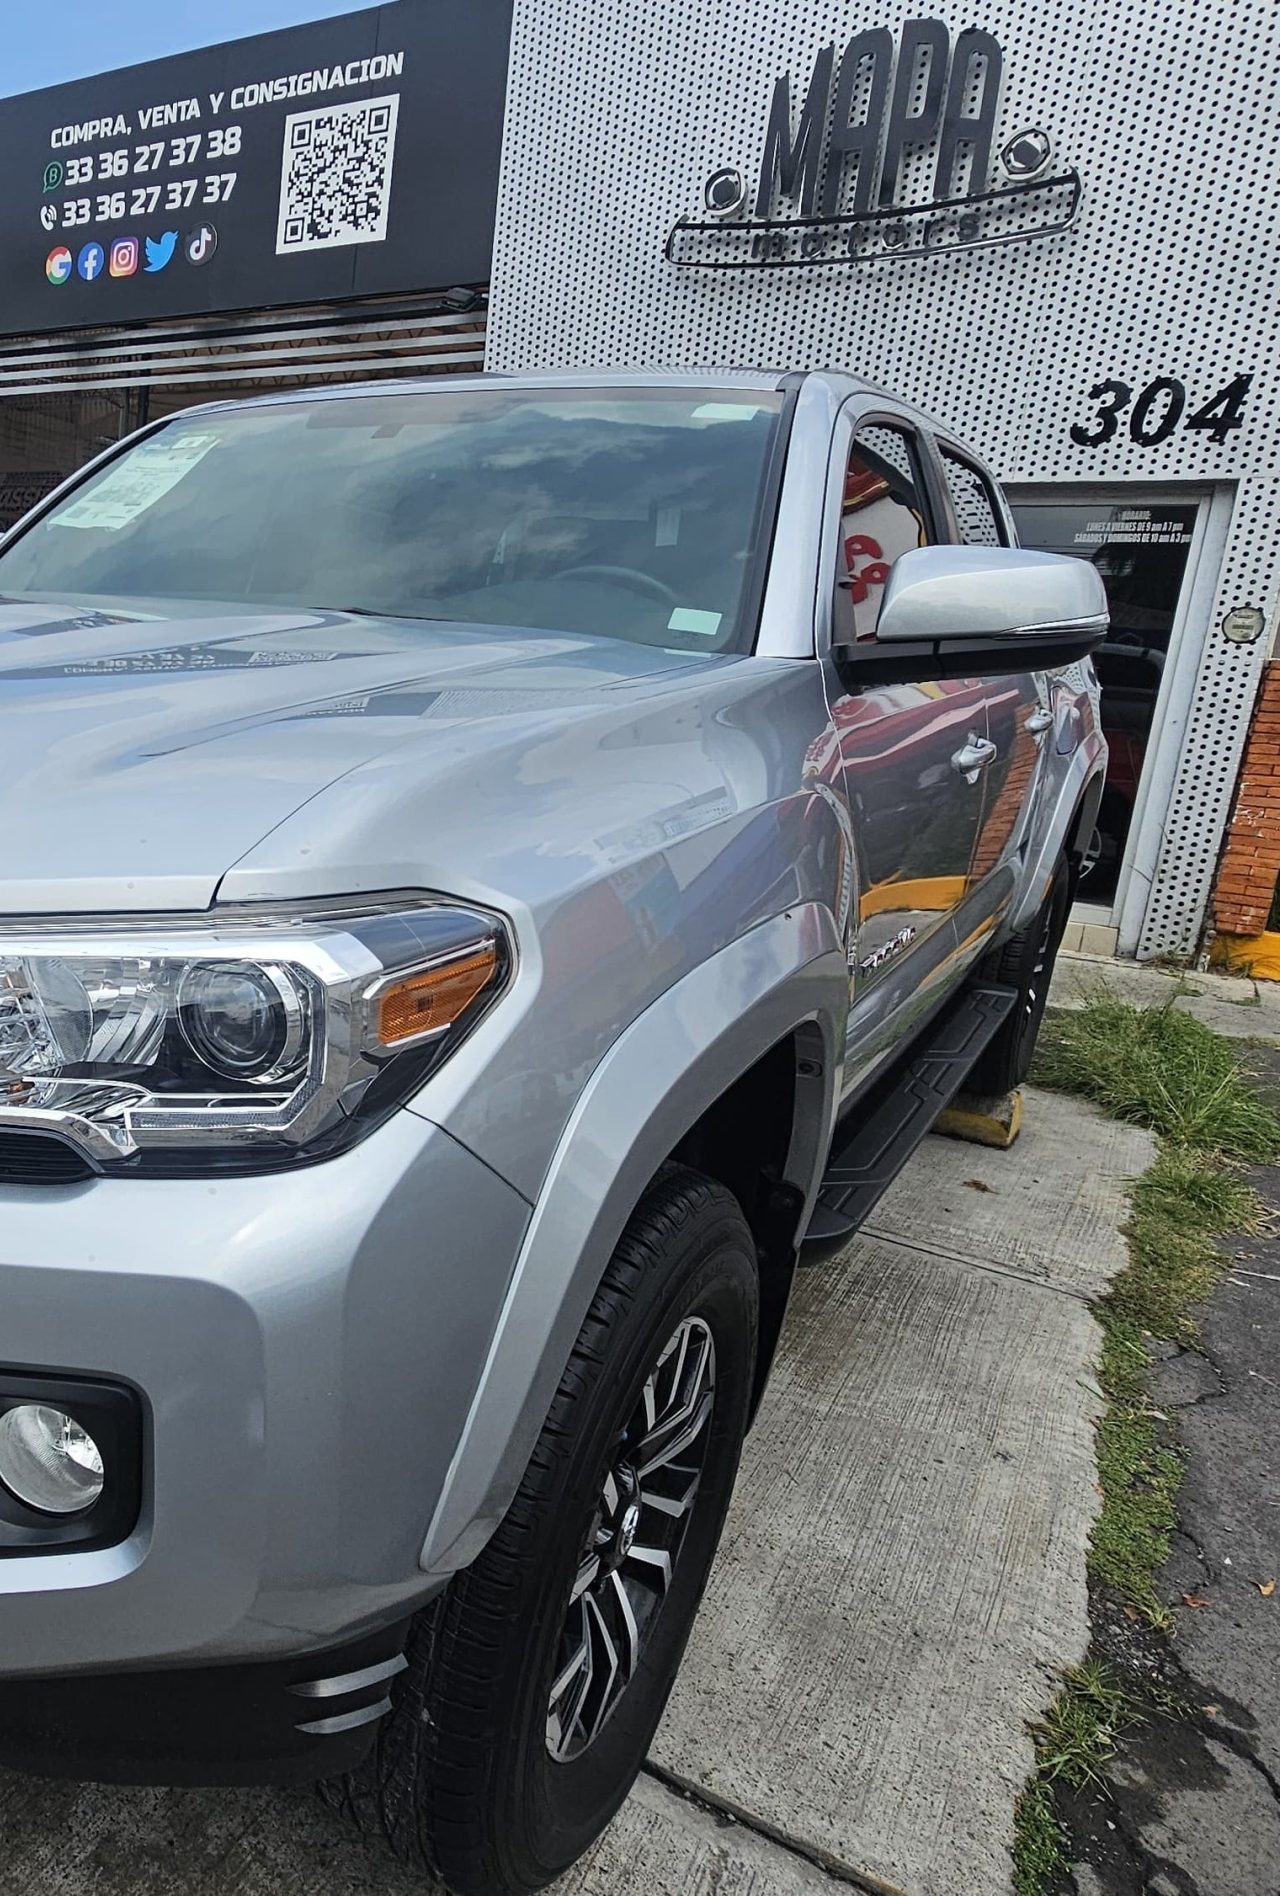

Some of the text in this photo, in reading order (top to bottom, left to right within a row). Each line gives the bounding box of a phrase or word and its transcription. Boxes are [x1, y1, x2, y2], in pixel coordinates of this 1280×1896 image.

[51, 51, 404, 149] COMPRA, VENTA Y CONSIGNACION
[754, 18, 1004, 219] MAPA
[64, 125, 242, 186] 33 36 27 37 38
[61, 172, 237, 228] 33 36 27 37 37
[750, 212, 981, 259] motors
[1069, 374, 1255, 448] 304
[1086, 521, 1106, 532] LUNES
[1137, 521, 1146, 532] DE
[1107, 533, 1141, 543] DOMINGOS
[1141, 533, 1150, 543] DE
